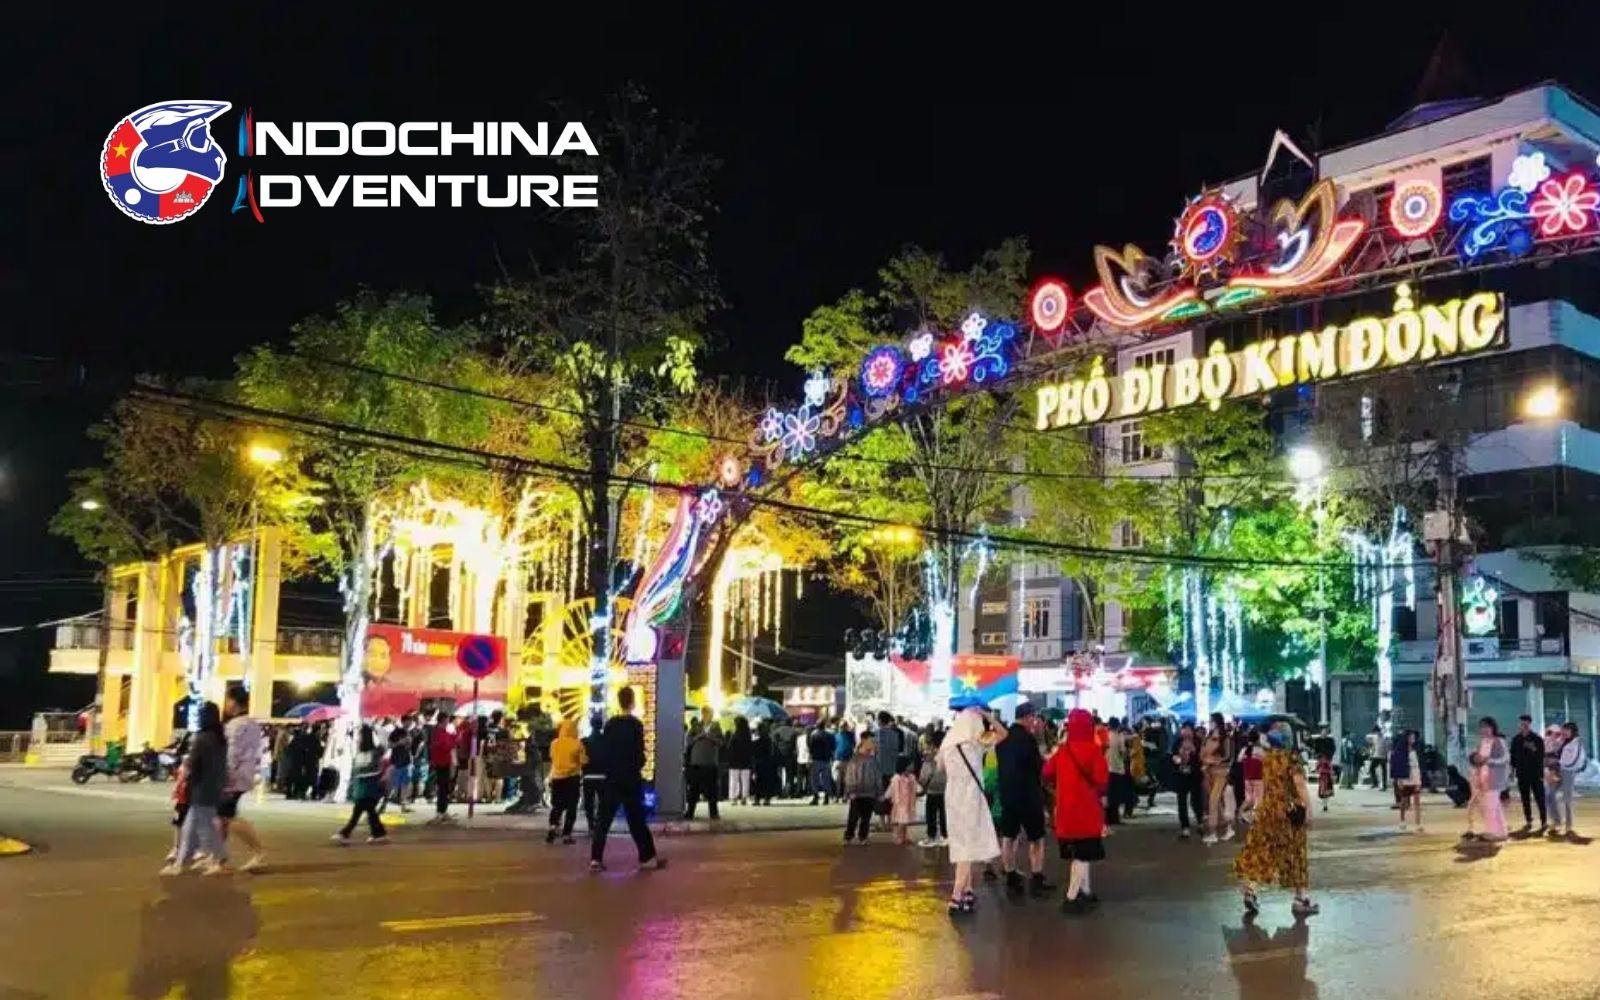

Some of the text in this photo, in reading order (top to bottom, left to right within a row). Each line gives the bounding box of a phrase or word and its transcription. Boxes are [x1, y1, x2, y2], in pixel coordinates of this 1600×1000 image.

[1035, 282, 1502, 430] PHỐ ĐI BỘ KIM ĐỒNG
